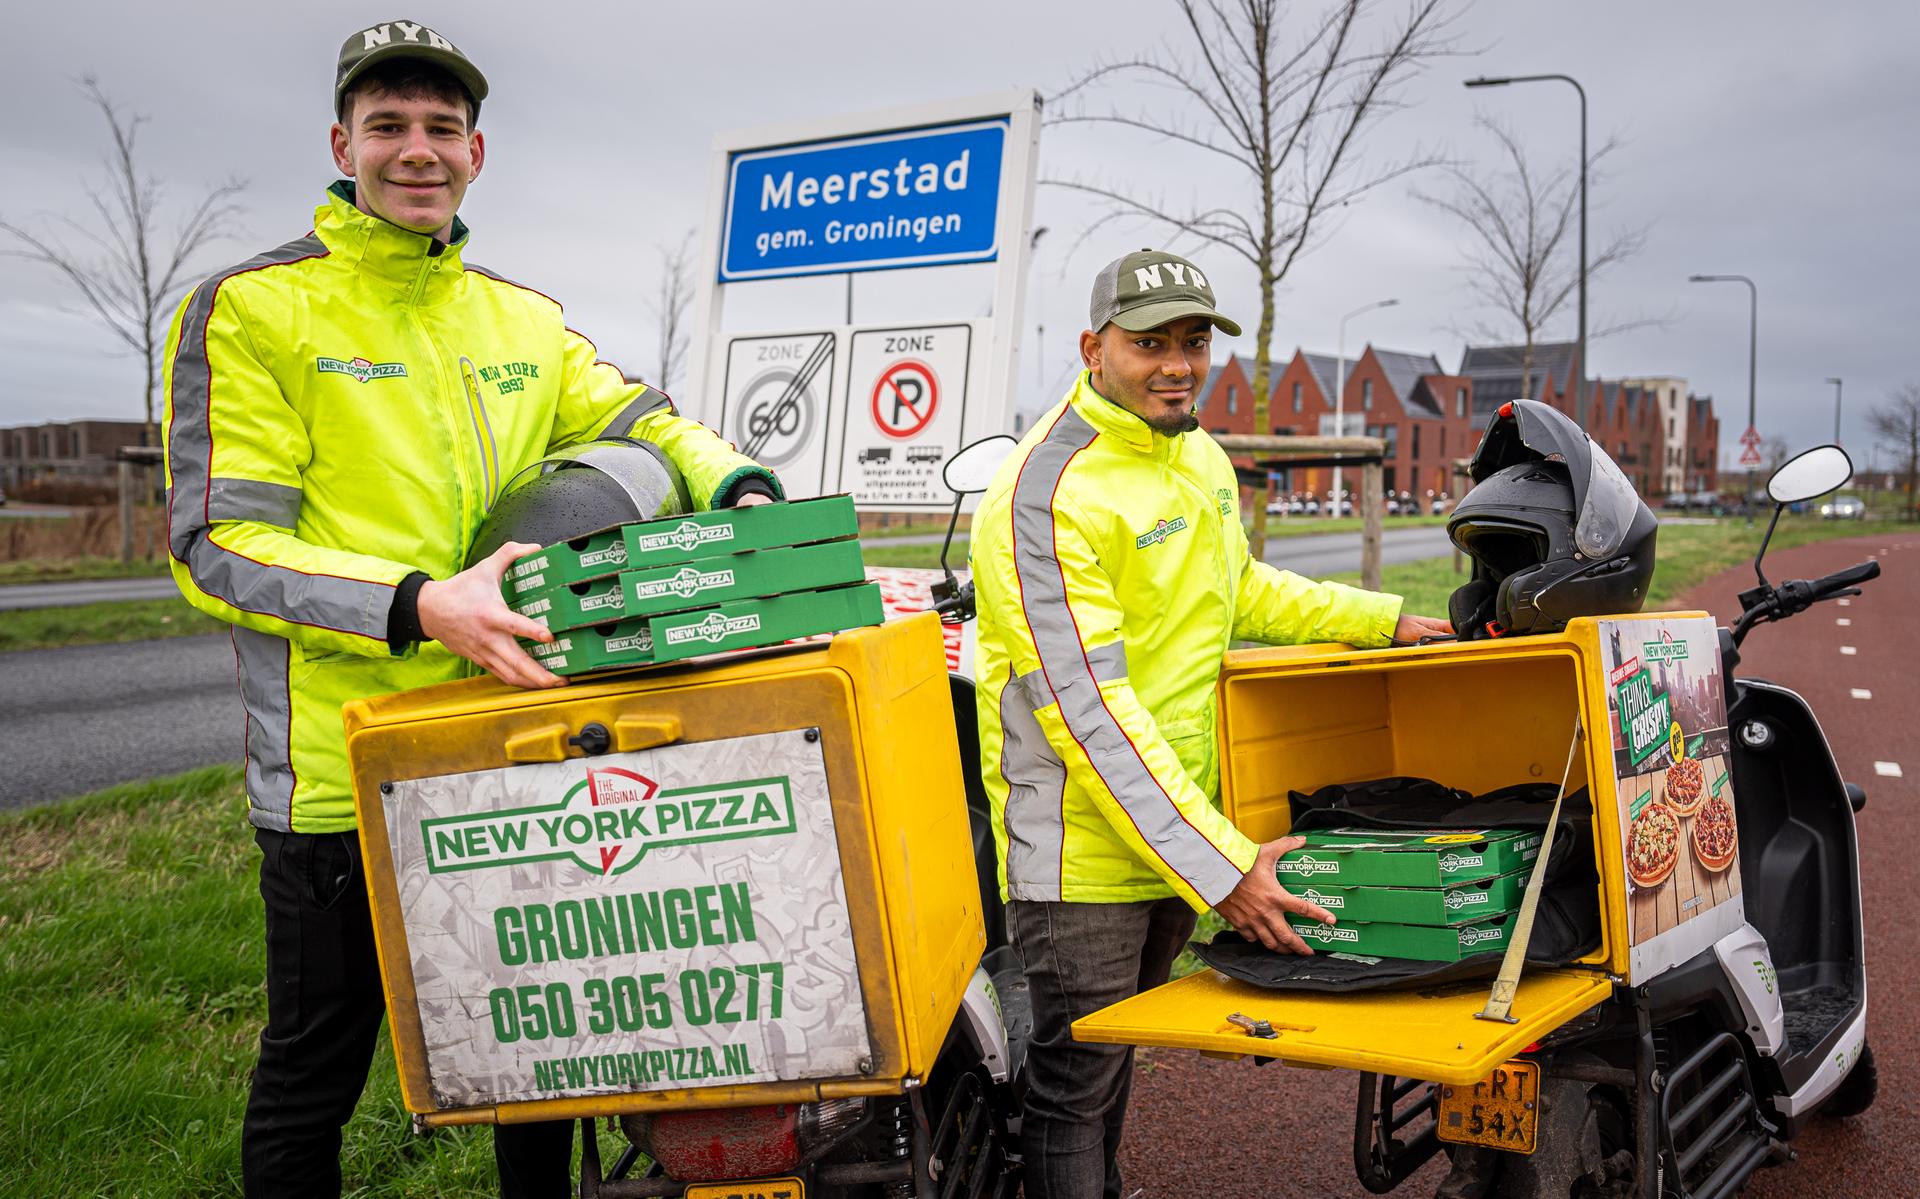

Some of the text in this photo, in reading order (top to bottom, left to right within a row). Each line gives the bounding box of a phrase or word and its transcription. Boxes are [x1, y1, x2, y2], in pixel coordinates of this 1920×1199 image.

[759, 149, 970, 212] Meerstad
[755, 213, 961, 257] gem. Groningen
[757, 343, 804, 362] ZONE
[884, 335, 935, 354] ZONE
[320, 360, 344, 370] NEW
[345, 364, 370, 376] YORK
[371, 366, 405, 376] PIZZA
[478, 361, 539, 383] NEW YORK
[497, 377, 525, 395] 1993
[748, 400, 801, 437] 60
[643, 536, 669, 548] NEW
[670, 532, 700, 544] YORK
[700, 527, 731, 540] PIZZA
[1138, 536, 1153, 547] NEW
[1152, 528, 1166, 540] YORK
[1166, 520, 1185, 533] PIZZA
[583, 548, 627, 565] NEW YORK
[640, 583, 667, 595] NEW
[668, 578, 698, 591] YORK
[699, 573, 731, 586] PIZZA
[583, 597, 603, 608] NEW
[669, 628, 695, 641] NEW
[696, 624, 726, 636] YORK
[726, 618, 757, 631] PIZZA
[608, 638, 629, 650] NEW
[1645, 644, 1687, 657] NEW YORK PIZZA
[1620, 679, 1642, 722] THIN
[1631, 698, 1668, 754] CRISPY
[597, 779, 614, 792] THE
[600, 788, 640, 806] ORIGINAL
[434, 791, 782, 861] NEW YORK PIZZA
[1276, 862, 1337, 871] NEW YORK PIZZA
[1439, 858, 1480, 868] YORK PIZZA
[1320, 898, 1342, 906] PIZZA
[1464, 894, 1486, 902] PIZZA
[493, 881, 757, 967] GRONINGEN
[1295, 927, 1357, 941] NEW YORK PIZZA
[1478, 930, 1500, 939] PIZZA
[488, 962, 784, 1044] 050 305 0277
[533, 1043, 755, 1092] NEWYORKPIZZA.NL
